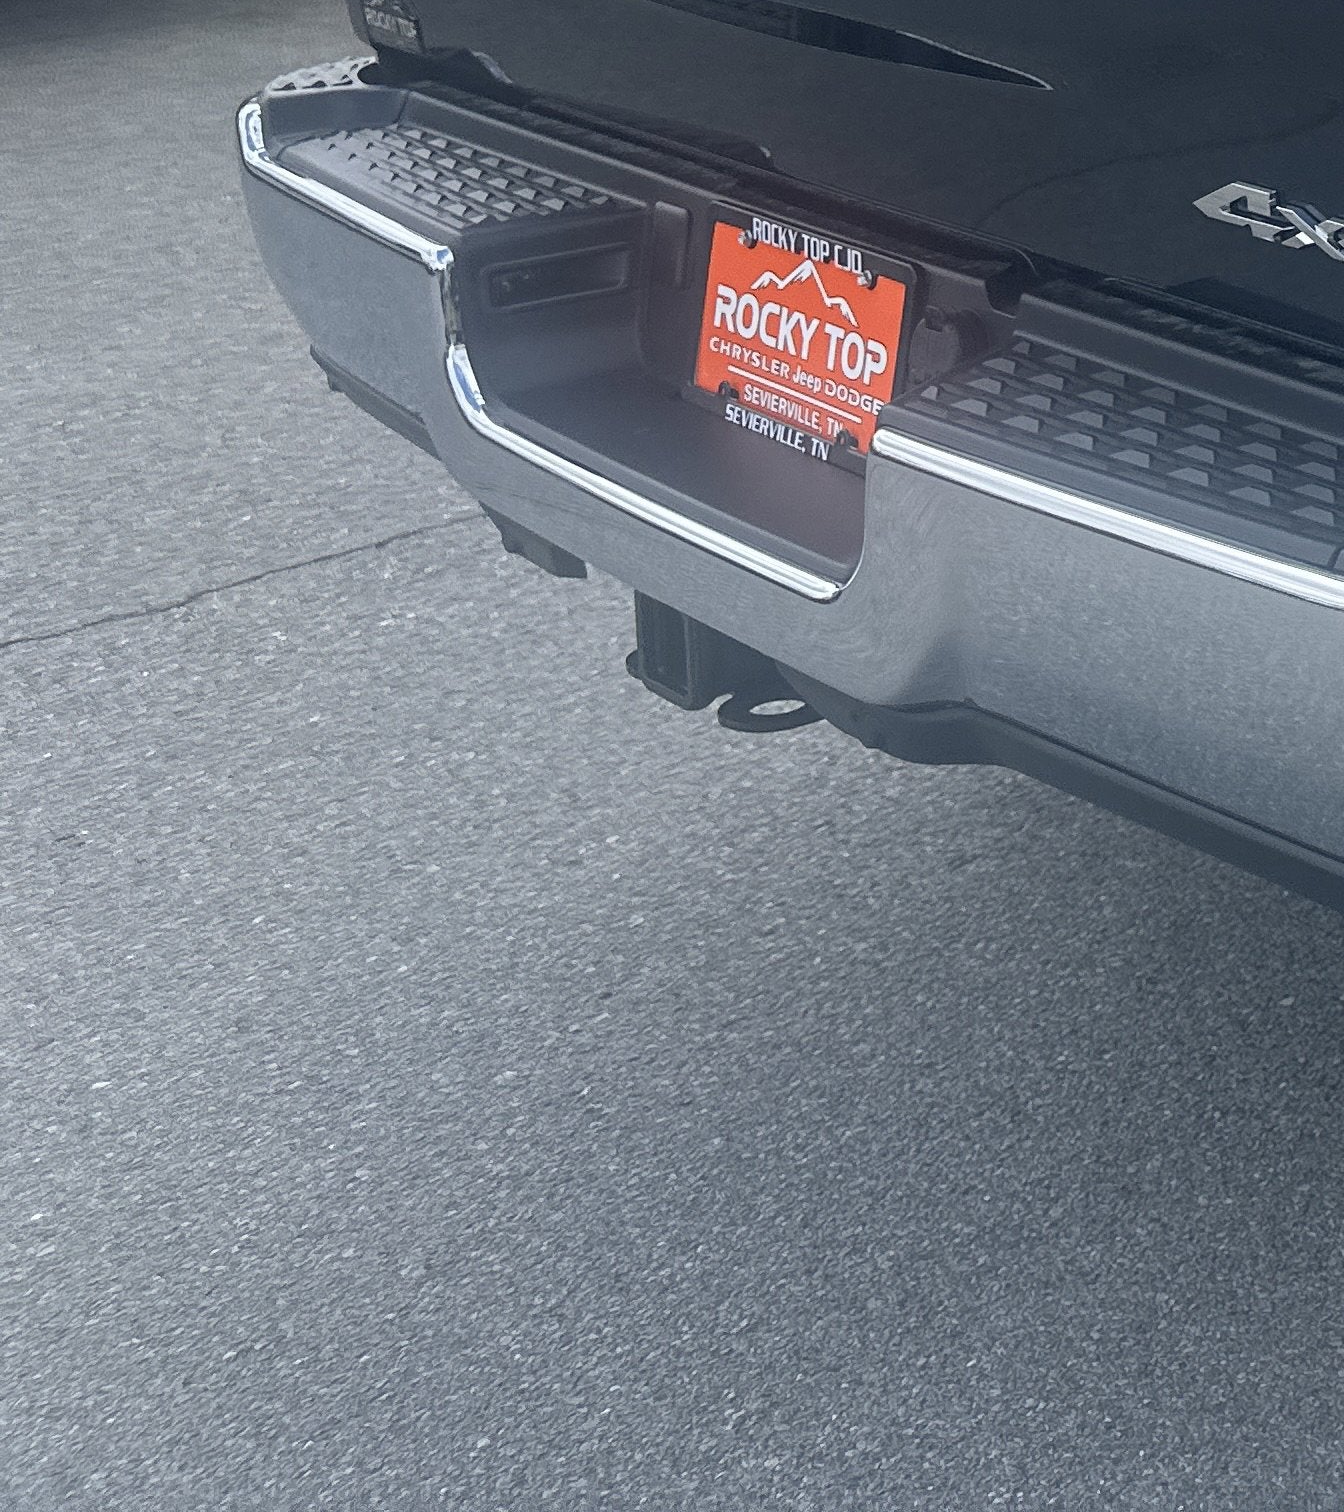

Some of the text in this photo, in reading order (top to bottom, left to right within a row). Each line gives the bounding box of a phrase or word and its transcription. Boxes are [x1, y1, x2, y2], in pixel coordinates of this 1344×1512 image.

[752, 217, 863, 276] ROCKY TOP CJD
[713, 283, 889, 386] ROCKY TOP
[709, 335, 885, 416] CHRYSLER Jeep DODGE
[743, 383, 823, 435] SEVIERVILLE,
[811, 437, 831, 462] TN
